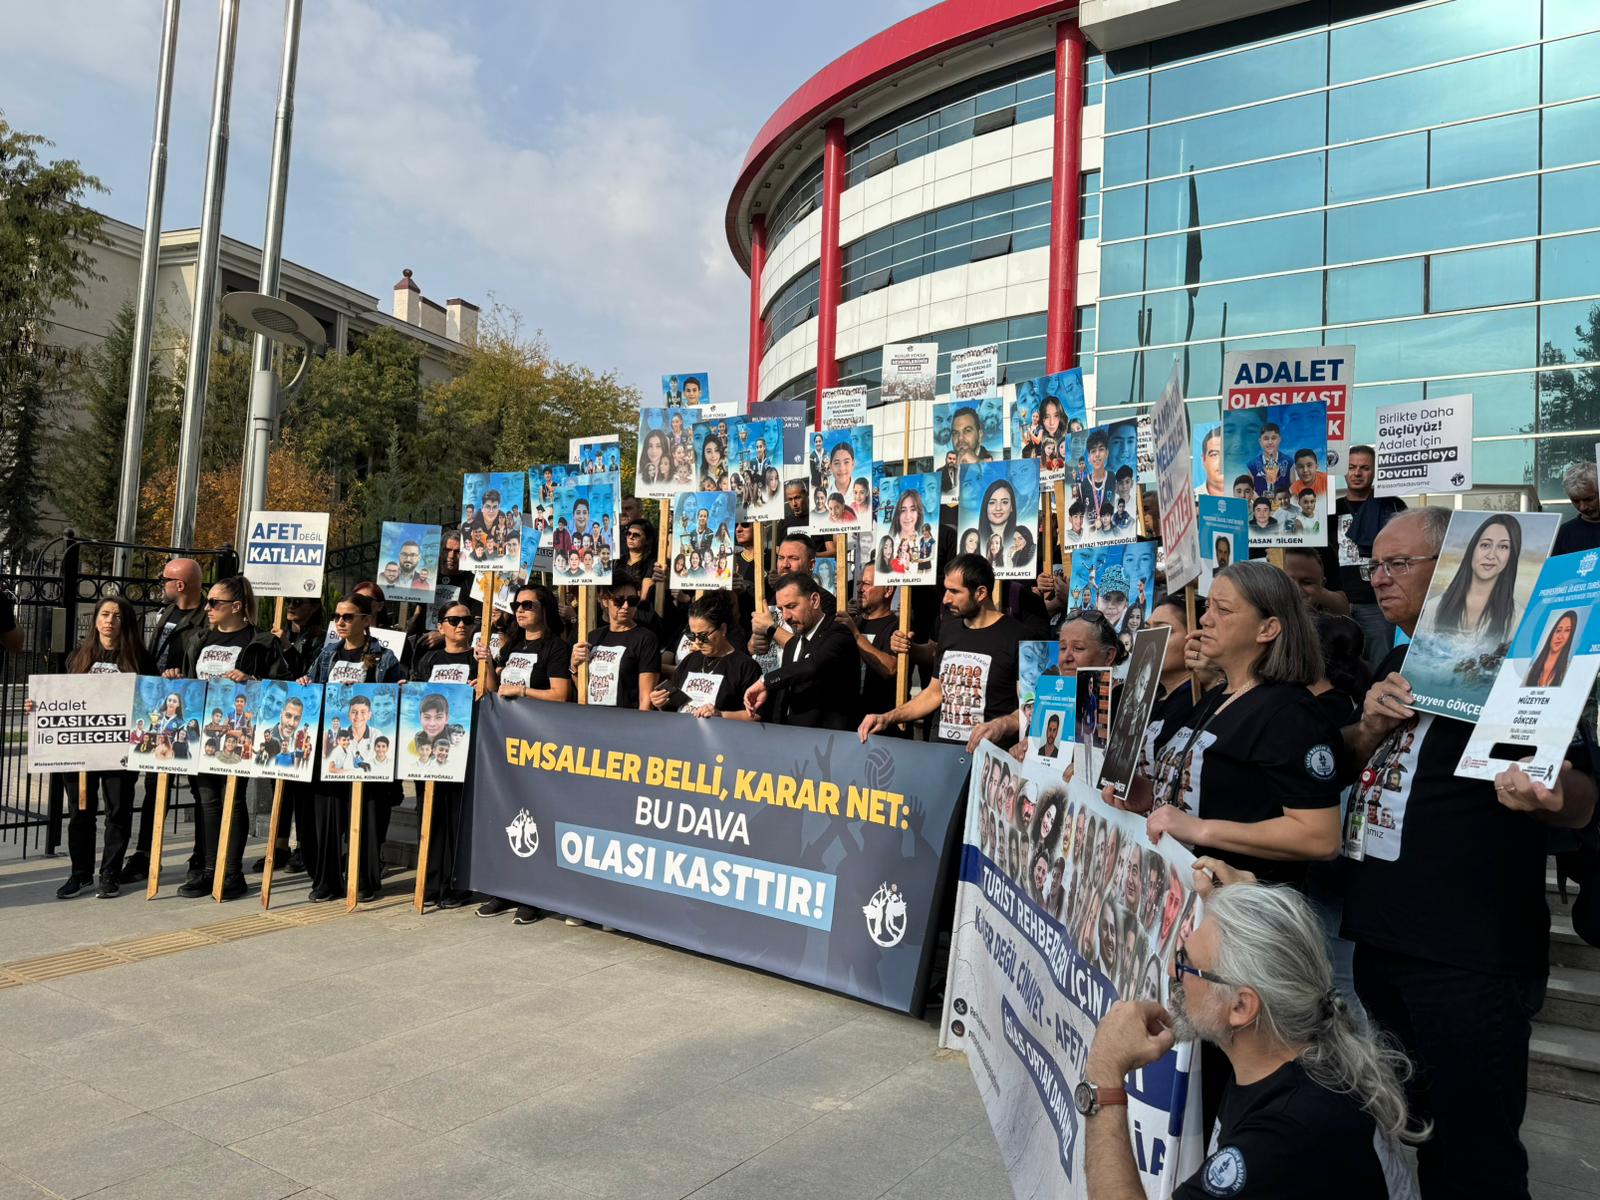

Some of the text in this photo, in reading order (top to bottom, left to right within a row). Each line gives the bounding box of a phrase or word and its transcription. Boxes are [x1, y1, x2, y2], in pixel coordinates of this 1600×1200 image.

[1234, 359, 1344, 385] ADALET
[1230, 391, 1344, 409] OLASI KAST
[1379, 407, 1454, 425] Birlikte Daha
[1379, 420, 1442, 438] Güçlüyüz!
[1378, 435, 1442, 451] Adalet İçin
[1378, 449, 1456, 465] Mücadeleye
[1378, 466, 1427, 479] Devam!
[251, 522, 323, 541] AFET DEĞİL
[249, 545, 322, 563] KATLİAM
[38, 699, 87, 711] Adalet
[1446, 697, 1483, 716] GÖKÇE
[1517, 695, 1550, 705] MÜZEYYEN
[38, 715, 126, 727] OLASI KAST
[1512, 714, 1538, 726] GÖKÇEN
[38, 731, 130, 744] İle GELECEK!
[506, 736, 910, 831] EMSALLER BELLİ, KARAR NET:
[635, 796, 750, 845] BU DAVA
[560, 831, 826, 920] OLASI KASTTIR!
[983, 865, 1103, 1022] TURİST REHBERLERİ İÇİN
[992, 932, 1017, 984] DEĞİL
[1017, 959, 1045, 1028] CİNAYET
[1026, 1041, 1054, 1100] ORTAK
[1049, 1080, 1073, 1161] DAVAMIZ
